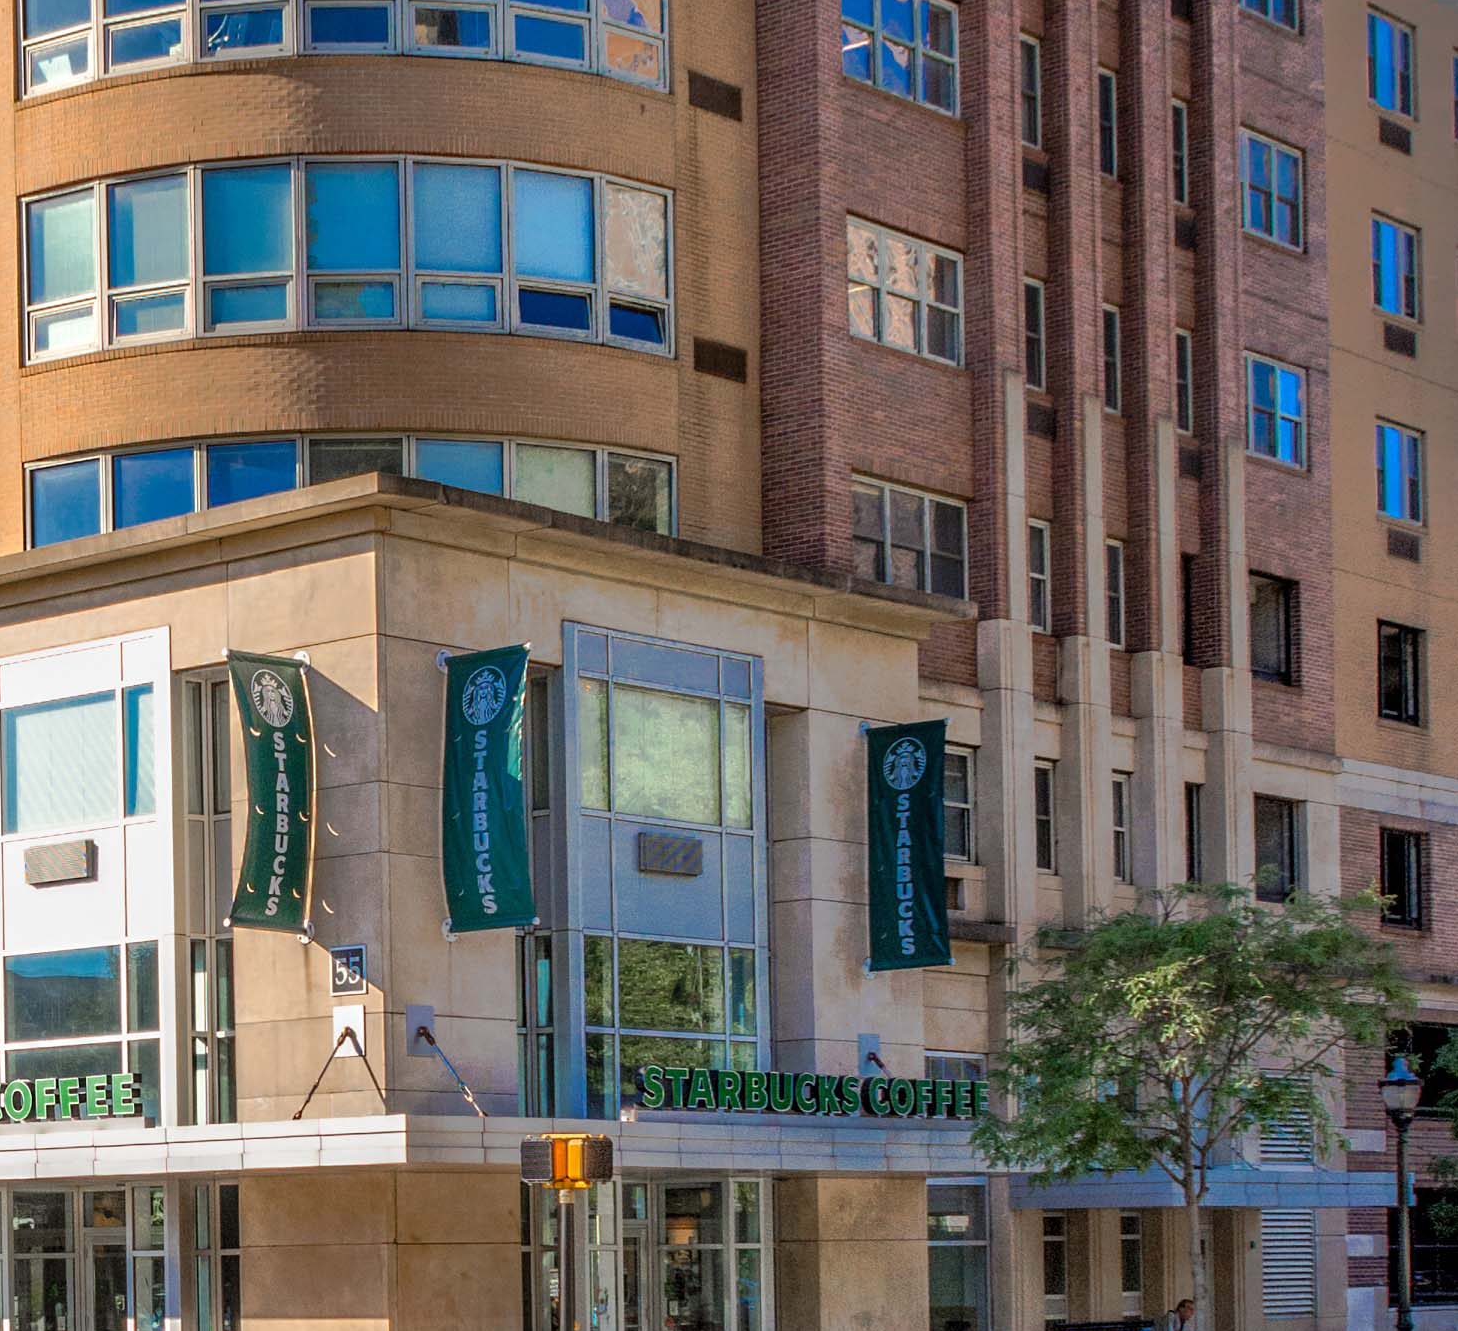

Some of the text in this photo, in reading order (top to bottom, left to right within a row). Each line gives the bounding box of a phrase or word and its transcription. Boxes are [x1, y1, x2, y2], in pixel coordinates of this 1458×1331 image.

[265, 731, 290, 917] STARBUCKS
[472, 729, 499, 915] STARBUCKS
[895, 793, 916, 956] STARBUCKS
[334, 956, 361, 986] 55
[640, 1065, 990, 1118] STARBUCKS COFFEE
